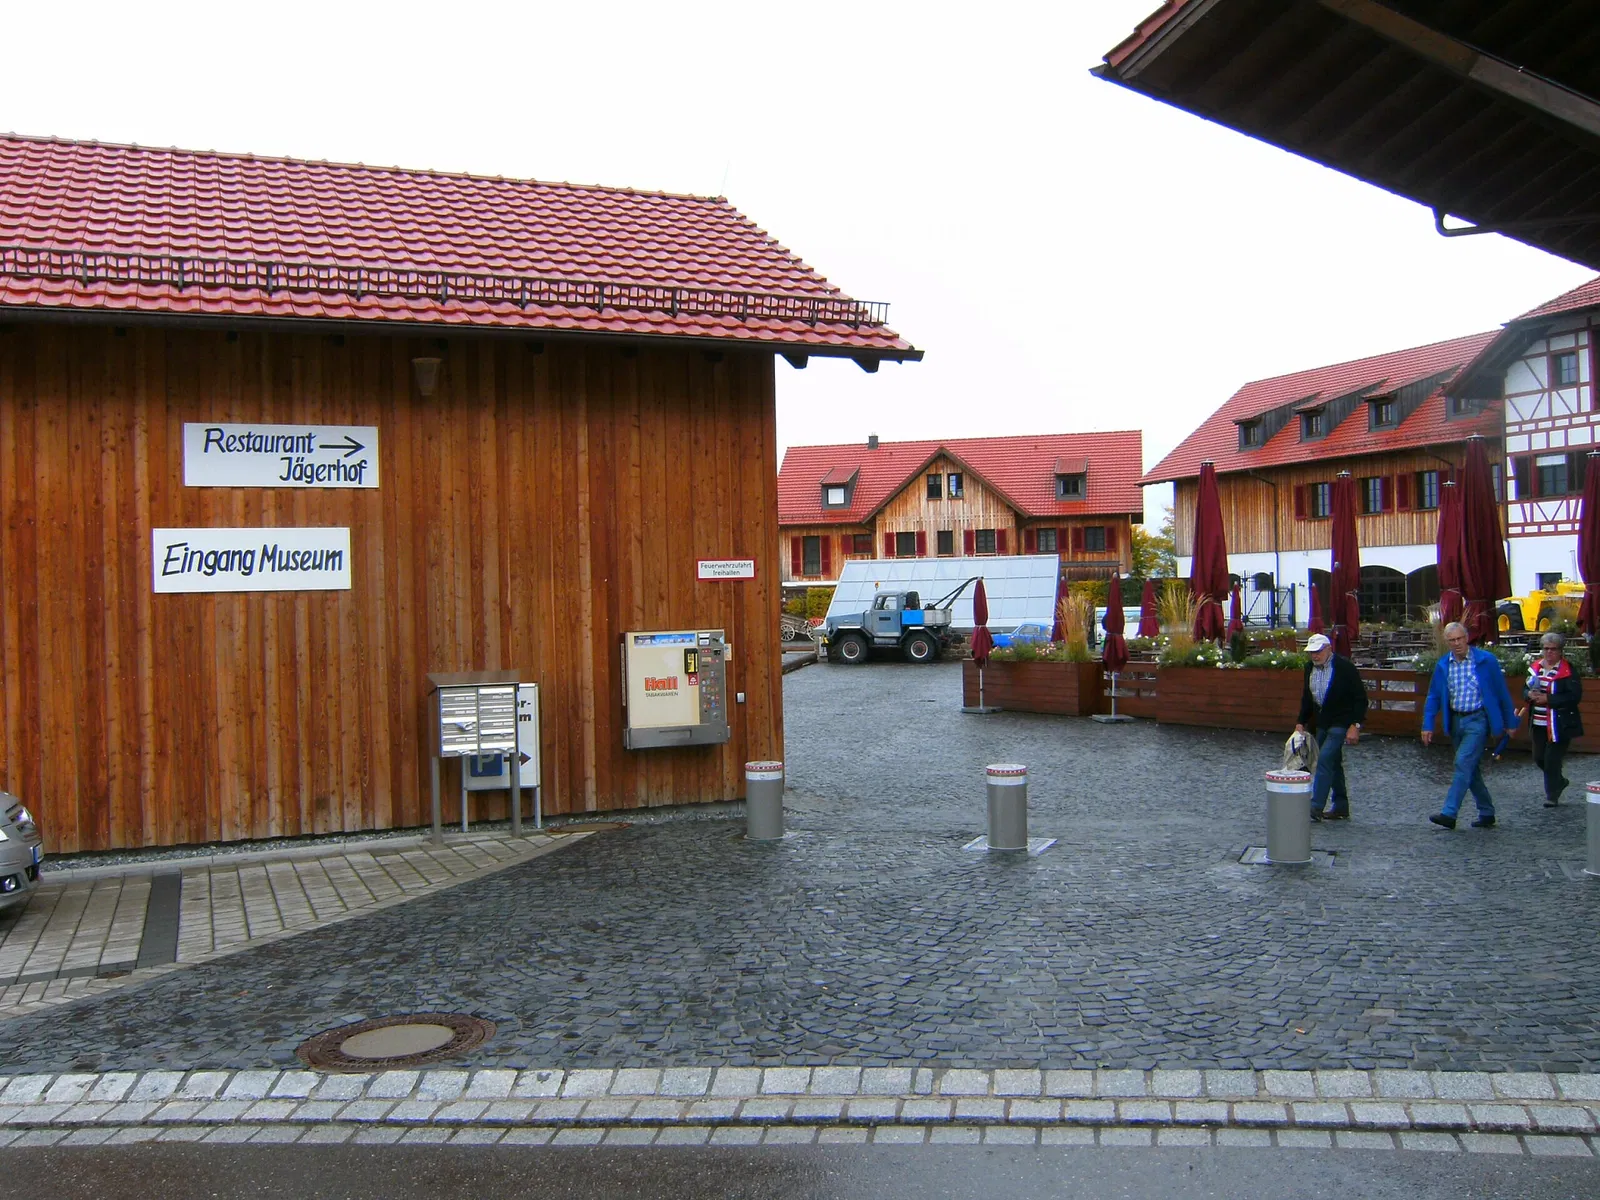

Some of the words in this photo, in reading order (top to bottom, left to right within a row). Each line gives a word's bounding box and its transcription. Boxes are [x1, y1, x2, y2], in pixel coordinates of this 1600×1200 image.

[203, 427, 316, 454] Restaurant
[279, 456, 368, 485] Jägerhof
[161, 542, 256, 577] Eingang
[258, 543, 343, 573] Museum
